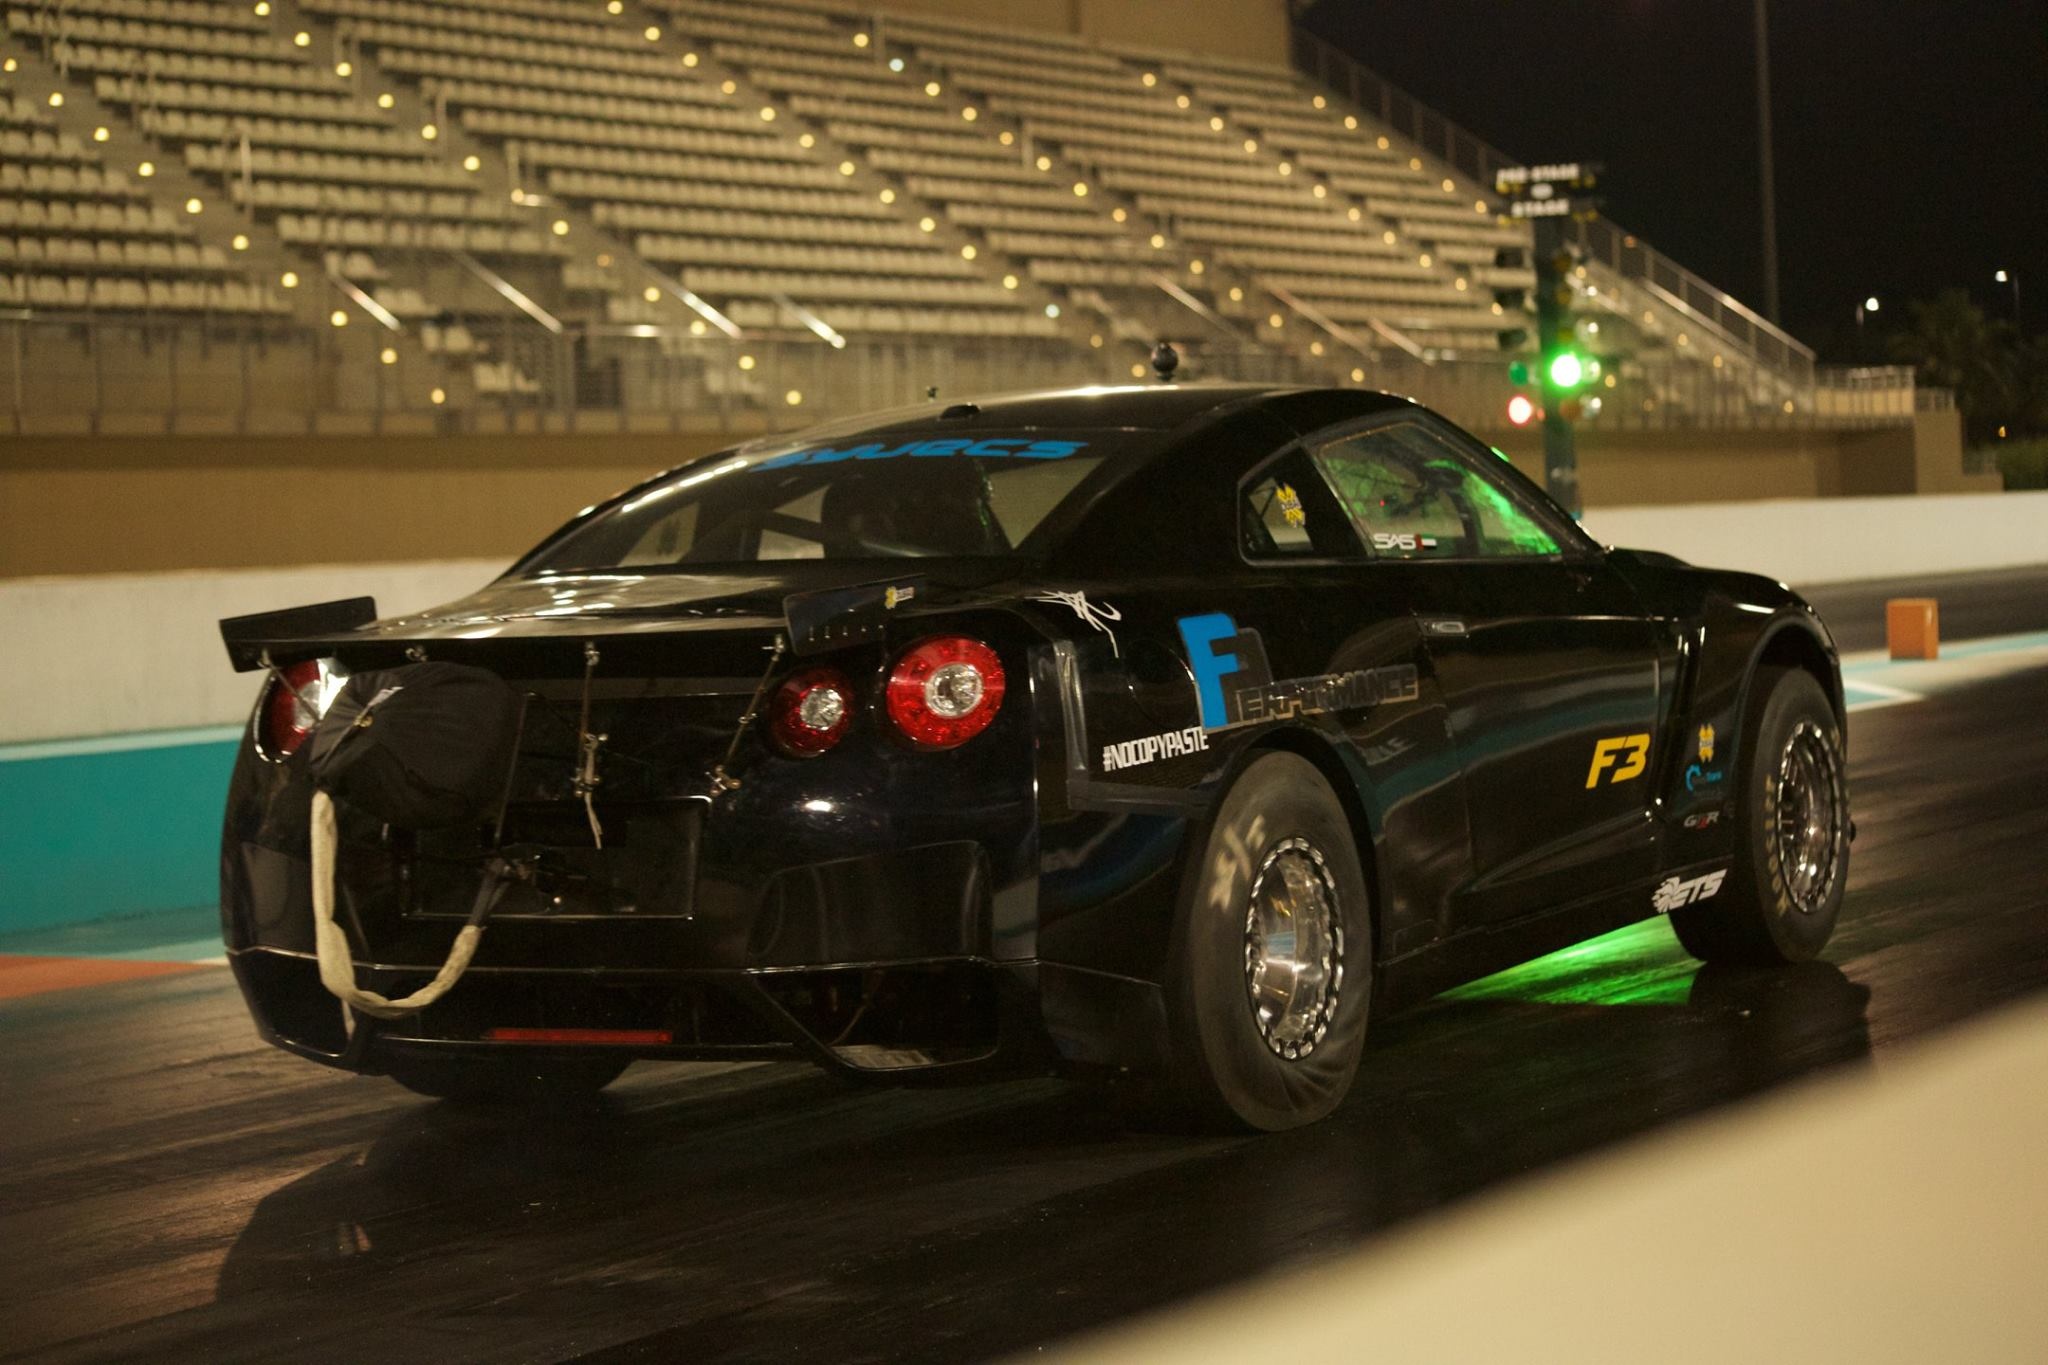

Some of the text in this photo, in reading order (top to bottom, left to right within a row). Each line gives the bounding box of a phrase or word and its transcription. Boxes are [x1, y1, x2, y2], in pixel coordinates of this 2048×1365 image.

[1103, 726, 1209, 772] #NOCOPYPASTE
[1585, 733, 1650, 789] F3
[1669, 868, 1728, 910] ETS
